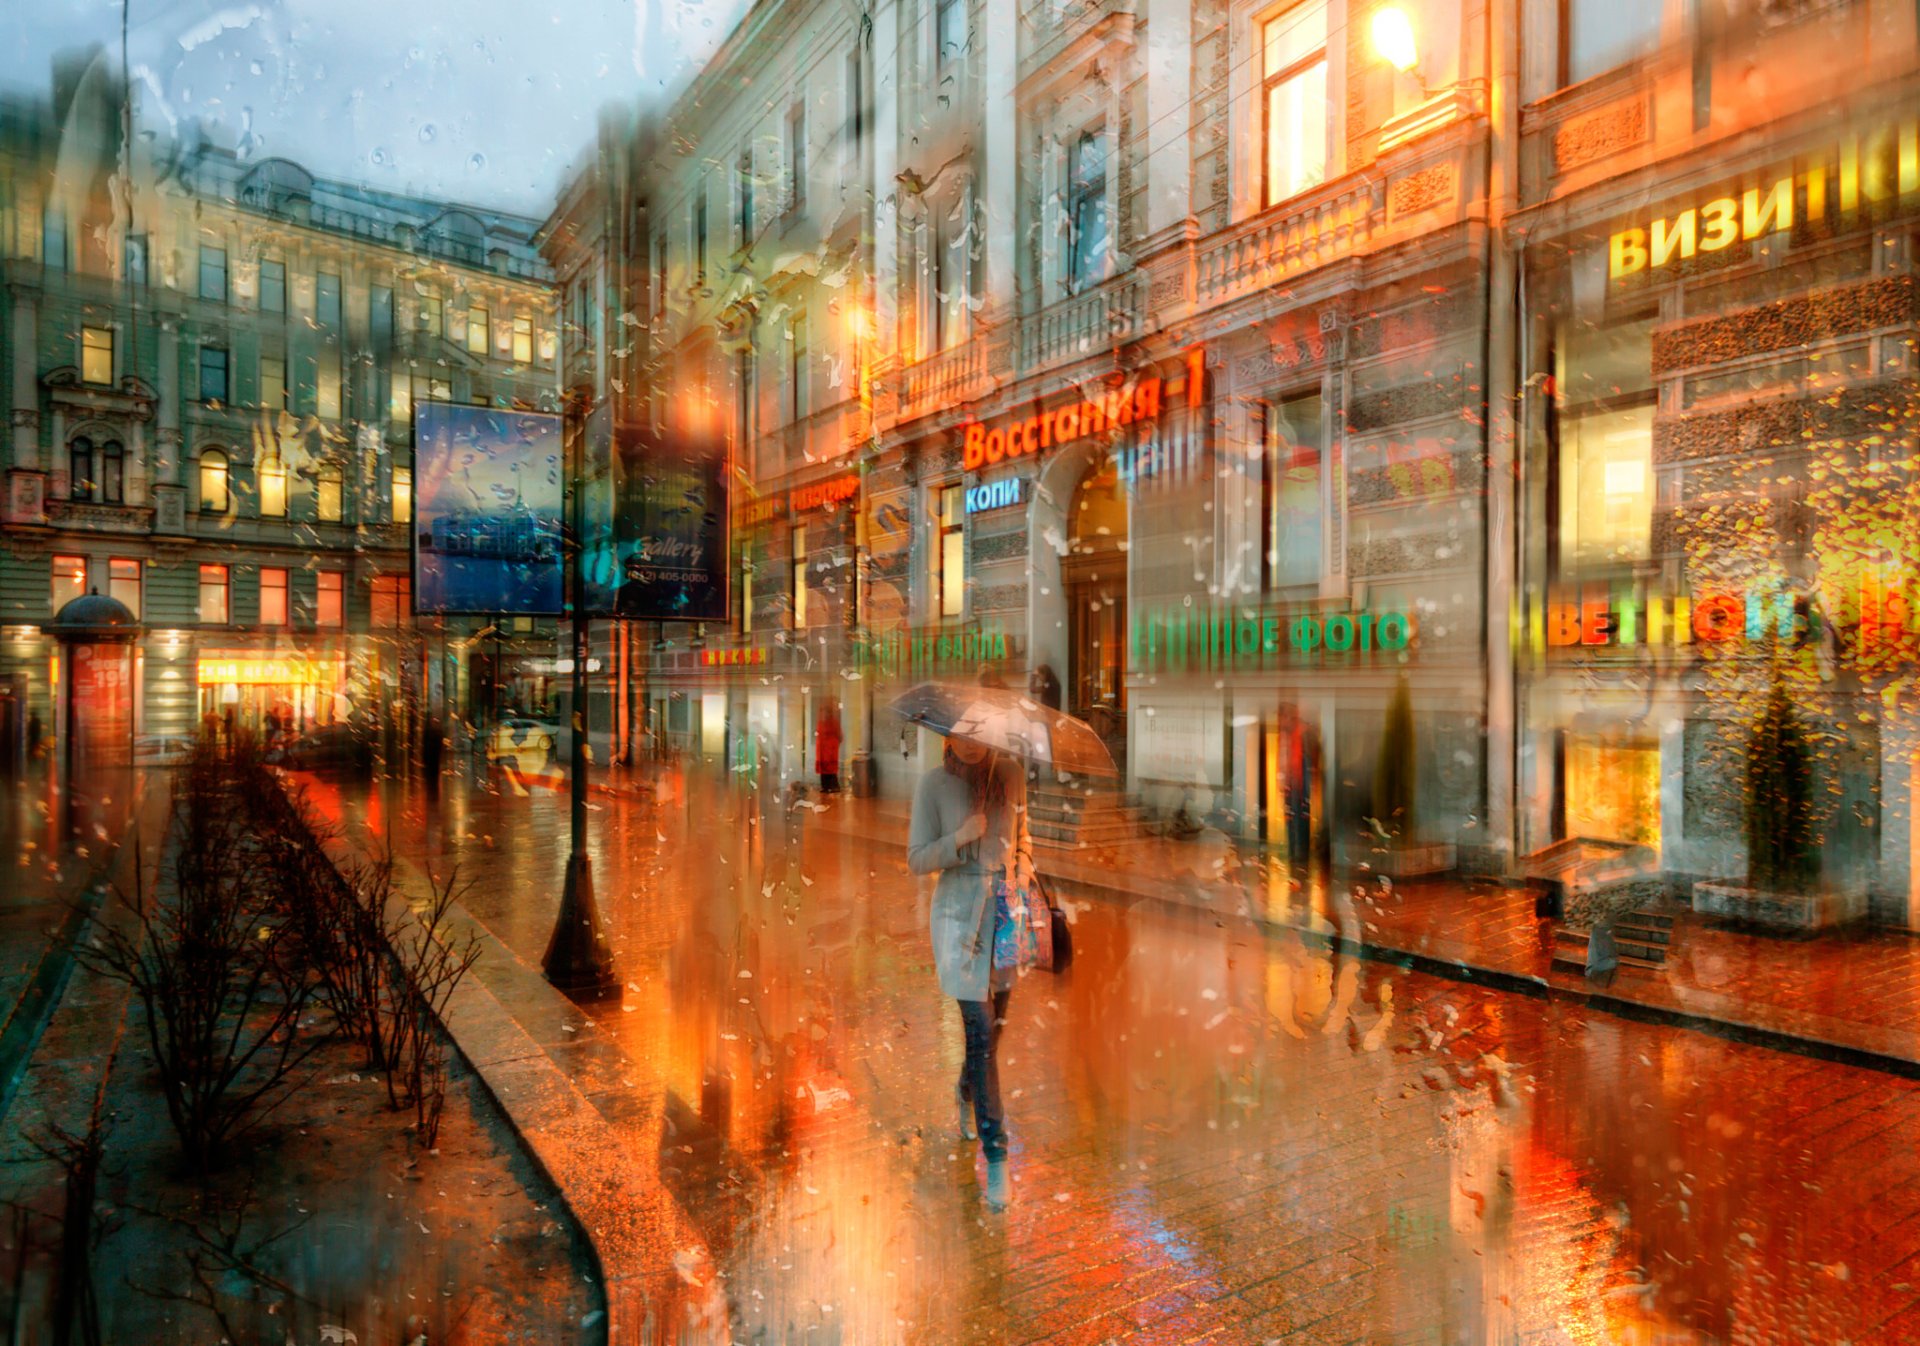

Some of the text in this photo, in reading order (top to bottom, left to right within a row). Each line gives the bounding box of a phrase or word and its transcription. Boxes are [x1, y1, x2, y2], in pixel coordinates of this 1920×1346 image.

[964, 349, 1204, 471] Восстания-1
[966, 476, 1020, 514] КОПИ
[634, 536, 703, 566] Gallery
[658, 570, 709, 583] 405-0000
[1290, 611, 1409, 652] ФОТО
